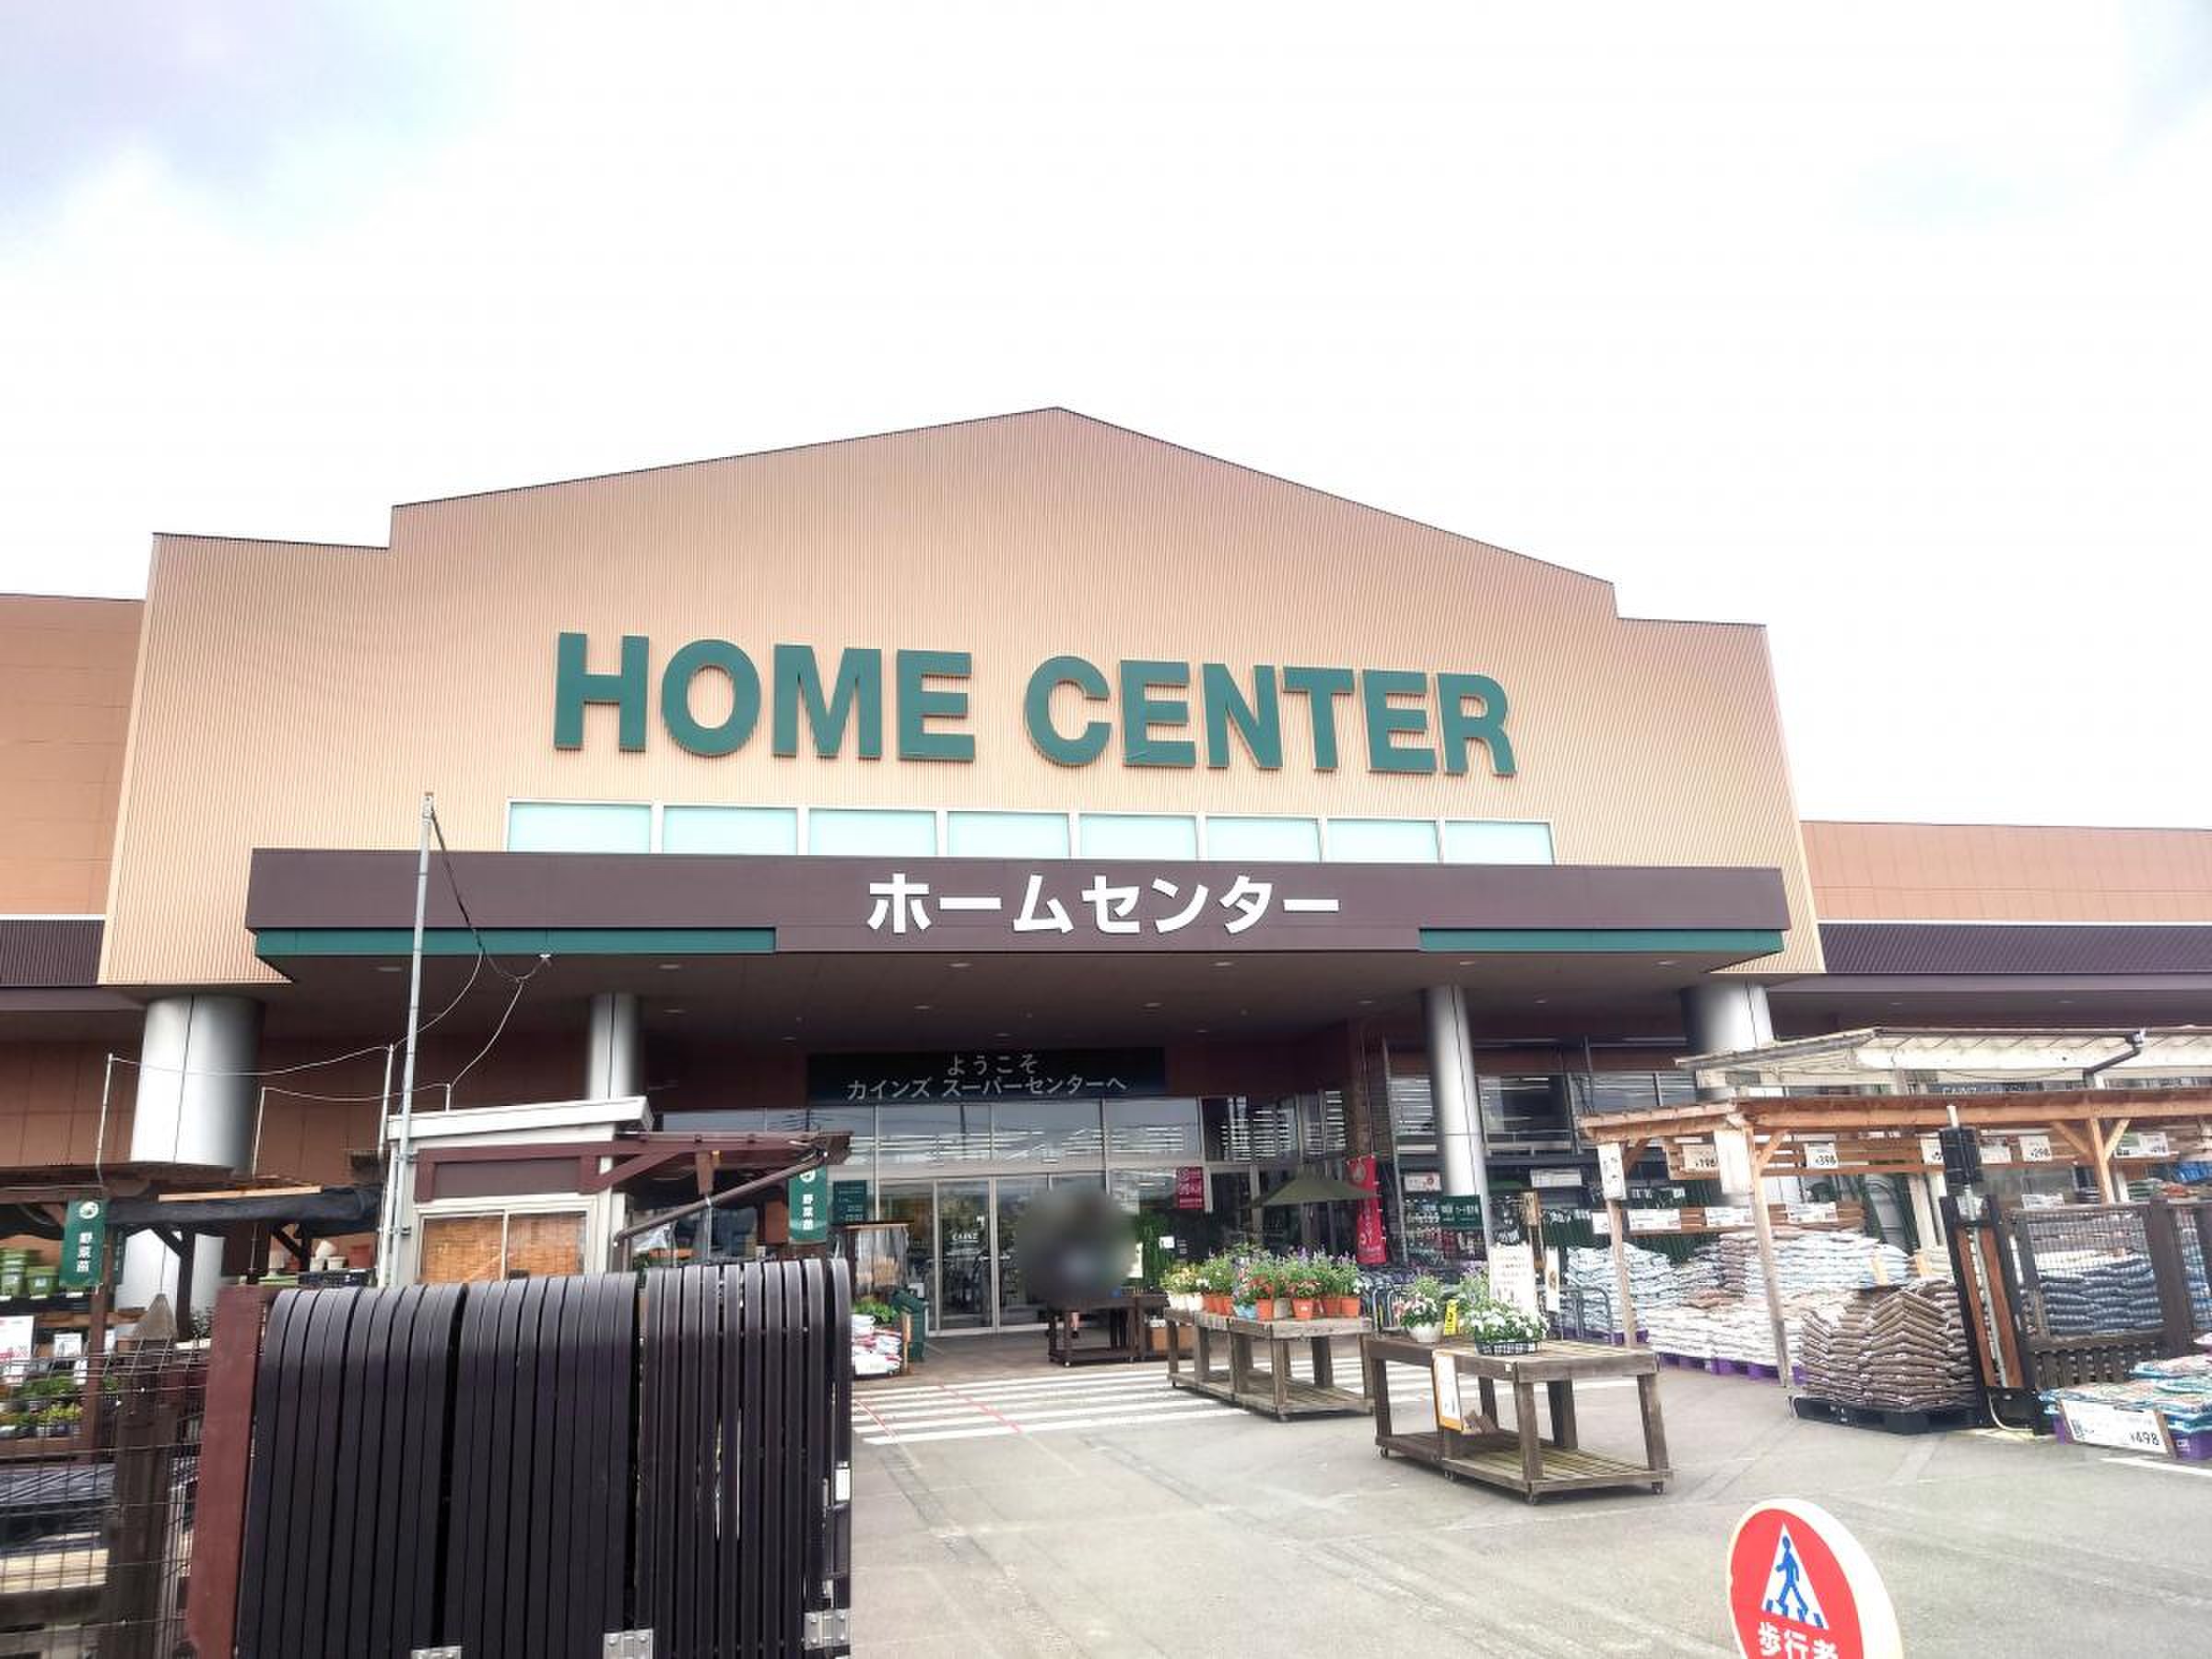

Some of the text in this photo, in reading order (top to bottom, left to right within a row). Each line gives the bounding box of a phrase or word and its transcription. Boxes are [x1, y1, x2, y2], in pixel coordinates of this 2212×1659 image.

[554, 632, 1517, 777] HOME CENTER
[867, 873, 1340, 934] ホームセンター
[947, 1053, 1038, 1076] ようこそ
[848, 1074, 1126, 1100] カインズ スーパーセンターへ
